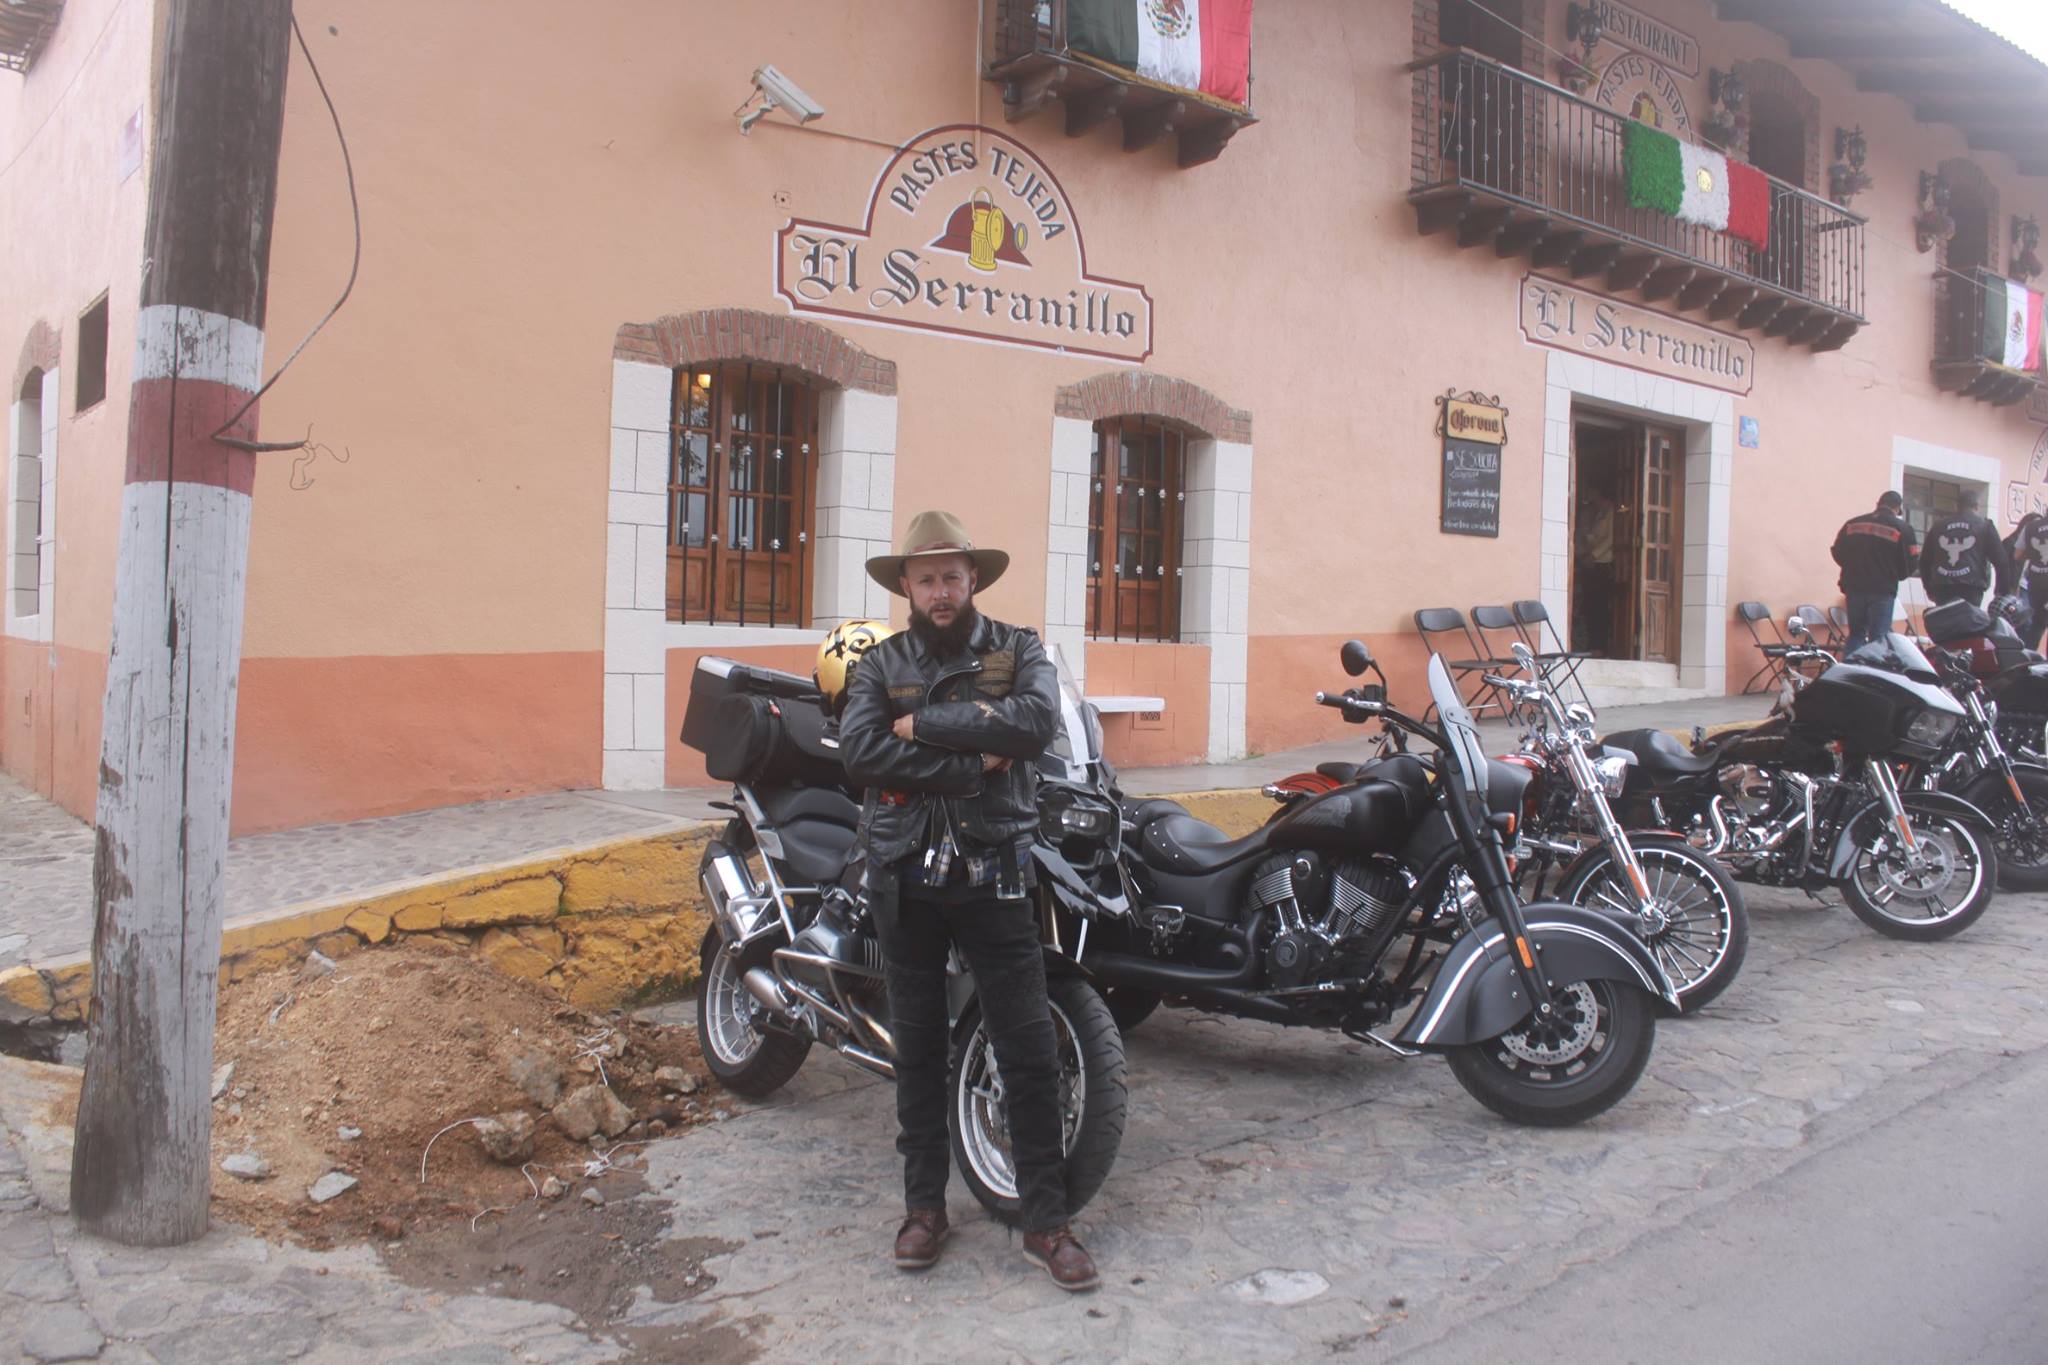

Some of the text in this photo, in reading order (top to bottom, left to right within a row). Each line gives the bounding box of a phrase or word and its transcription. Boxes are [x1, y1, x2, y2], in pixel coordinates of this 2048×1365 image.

[1600, 1, 1689, 65] RESTAURANT
[1602, 55, 1687, 130] PASTES TEJEDA
[890, 141, 1066, 241] PASTES TEJEDA
[793, 234, 1136, 338] El Serranillo
[1528, 285, 1744, 378] El Serranillo
[1450, 408, 1499, 433] Corona
